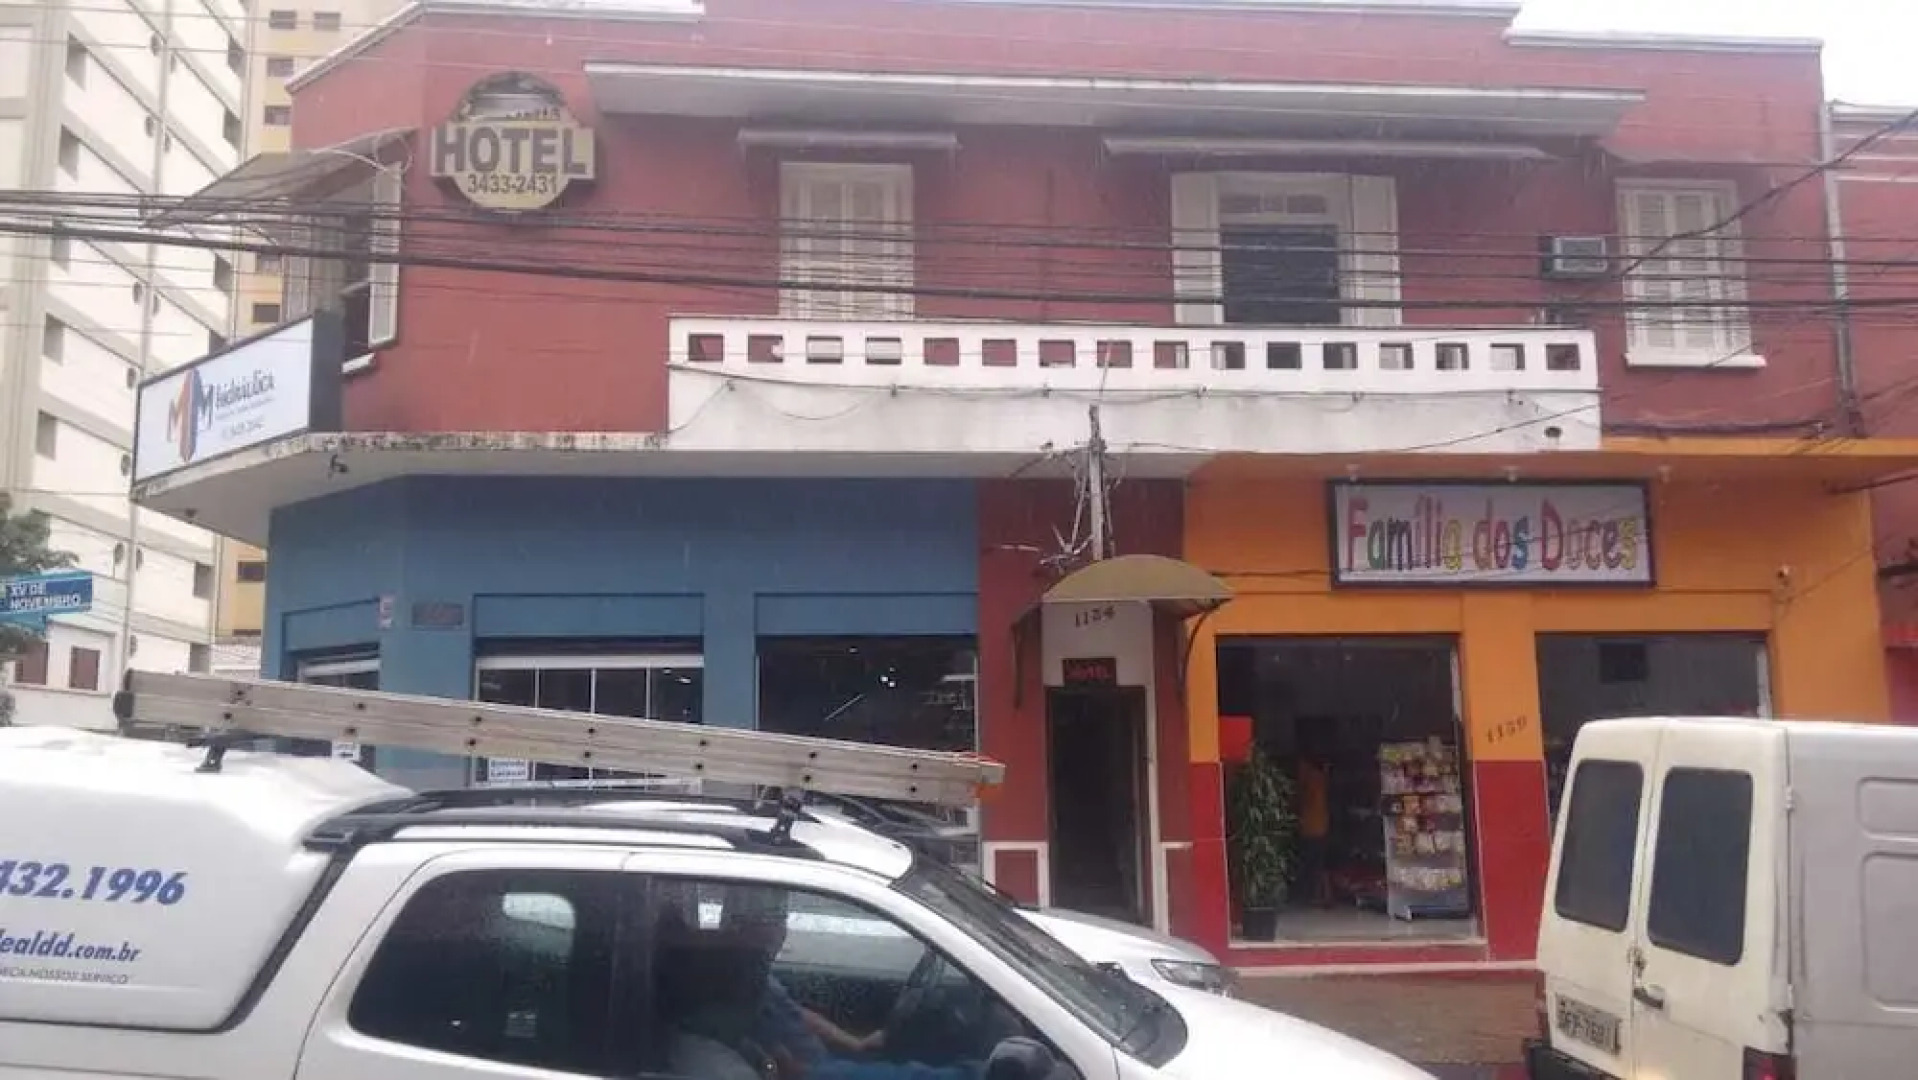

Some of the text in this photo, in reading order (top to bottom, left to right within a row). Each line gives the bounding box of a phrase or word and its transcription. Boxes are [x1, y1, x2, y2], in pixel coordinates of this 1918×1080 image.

[434, 126, 587, 174] HOTEL
[467, 172, 557, 194] 3433-2431
[1472, 496, 1530, 570] dos
[1541, 498, 1637, 572] Doces
